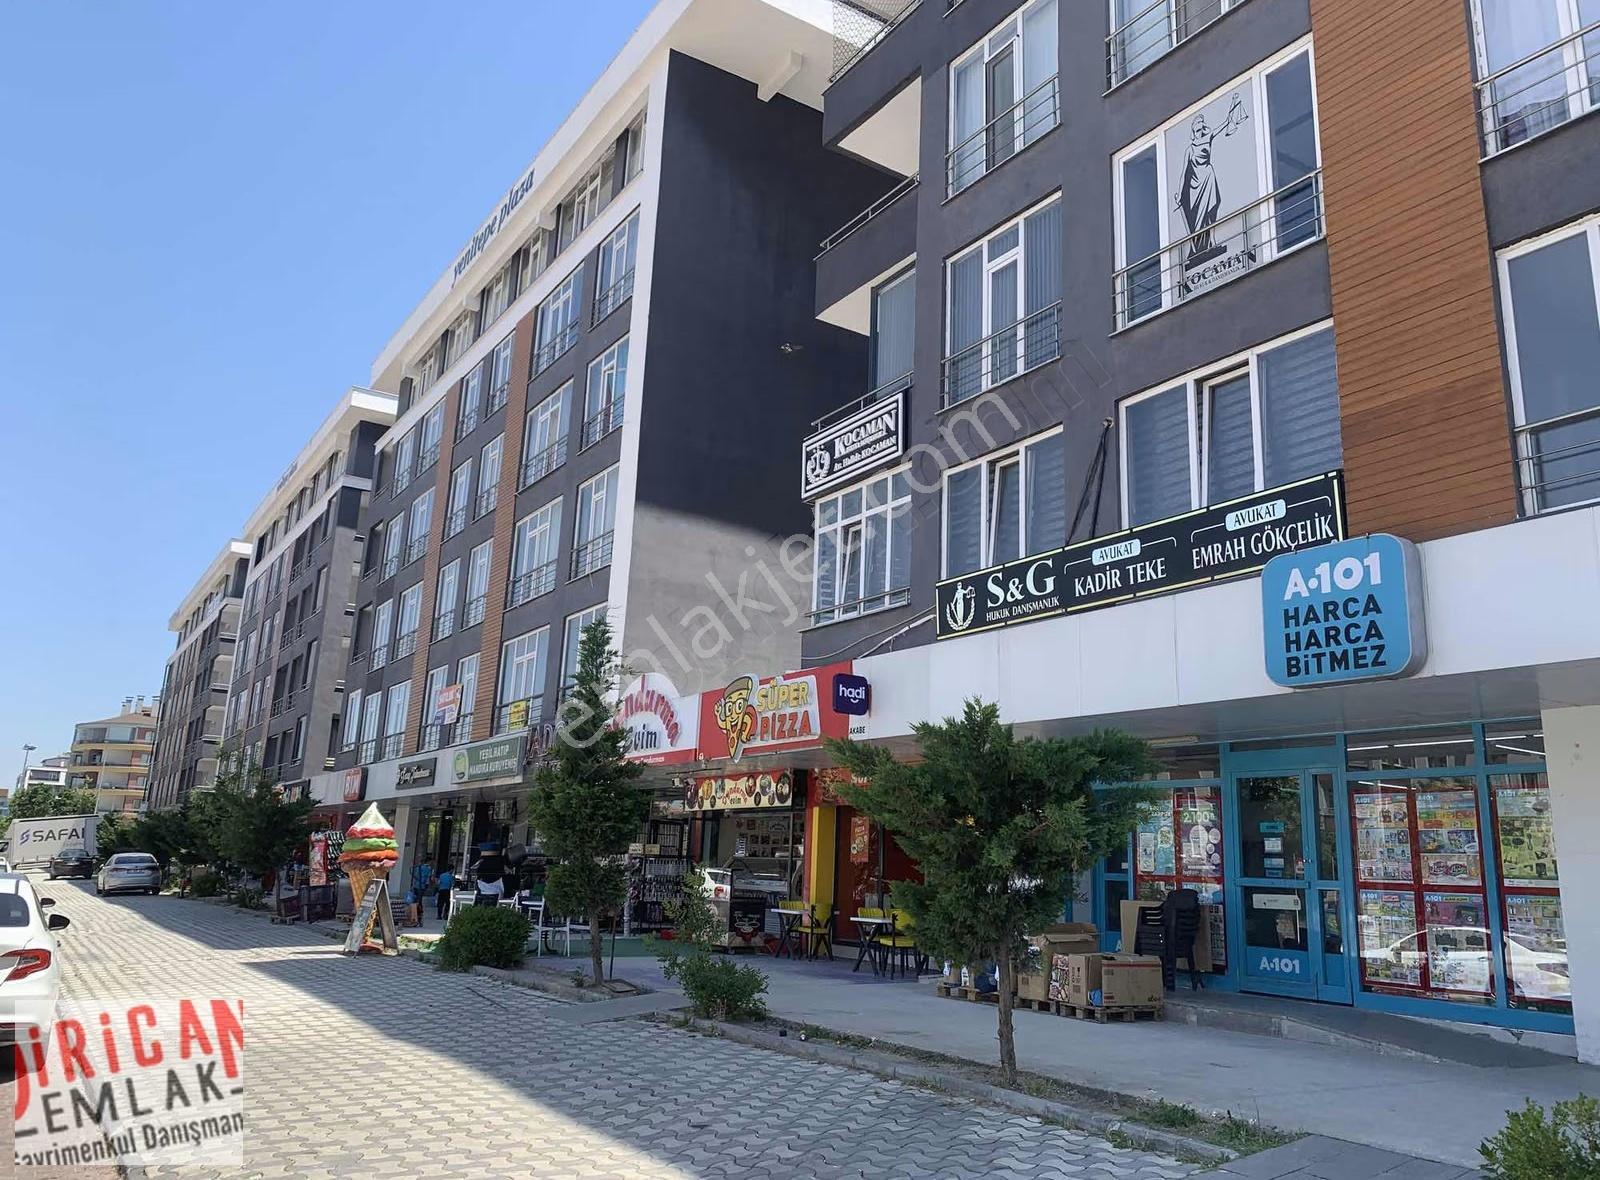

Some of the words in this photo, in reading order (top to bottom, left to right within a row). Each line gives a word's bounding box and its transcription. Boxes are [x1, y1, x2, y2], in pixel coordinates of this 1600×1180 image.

[1177, 244, 1258, 298] KOCAMAN
[834, 409, 898, 459] KOCAMAN
[861, 435, 897, 459] KOCAMAN
[1233, 503, 1278, 527] AVUKAT
[1099, 542, 1135, 561] AVUKAT
[1192, 536, 1246, 570] EMRAH
[1250, 512, 1335, 554] GÖKÇELİK
[987, 558, 1057, 608] S&G
[1074, 565, 1122, 597] KADİR
[1126, 557, 1167, 583] TEKE
[986, 608, 1010, 622] HUKUK
[1012, 595, 1060, 616] DANIŞMANLIK
[1283, 594, 1382, 629] HARCA
[1285, 620, 1384, 653] HARCA
[757, 679, 810, 712] SÜPER
[839, 684, 865, 701] hadi
